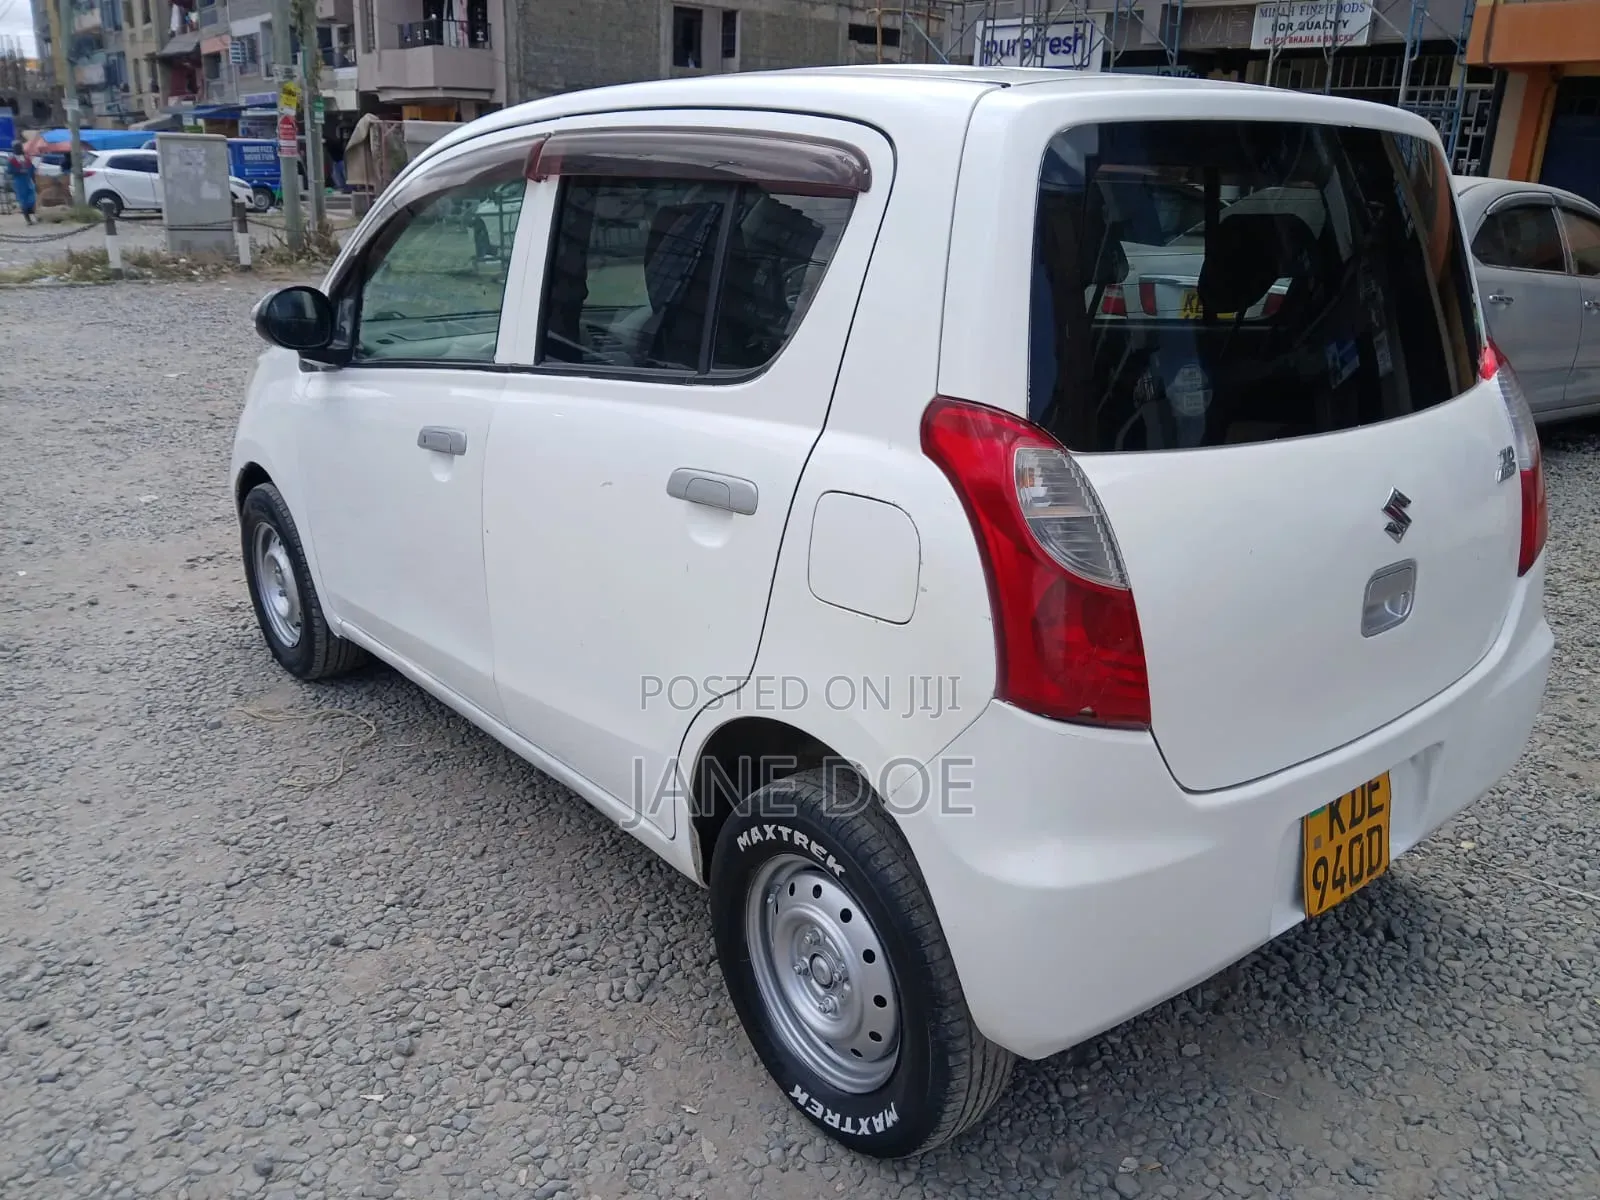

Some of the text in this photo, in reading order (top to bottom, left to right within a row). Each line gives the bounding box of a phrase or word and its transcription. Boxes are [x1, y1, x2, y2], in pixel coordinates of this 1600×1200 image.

[1328, 780, 1384, 841] KDE
[736, 824, 846, 877] MAXTREK
[1312, 824, 1383, 910] 940D
[788, 1084, 900, 1135] MAXTREK
